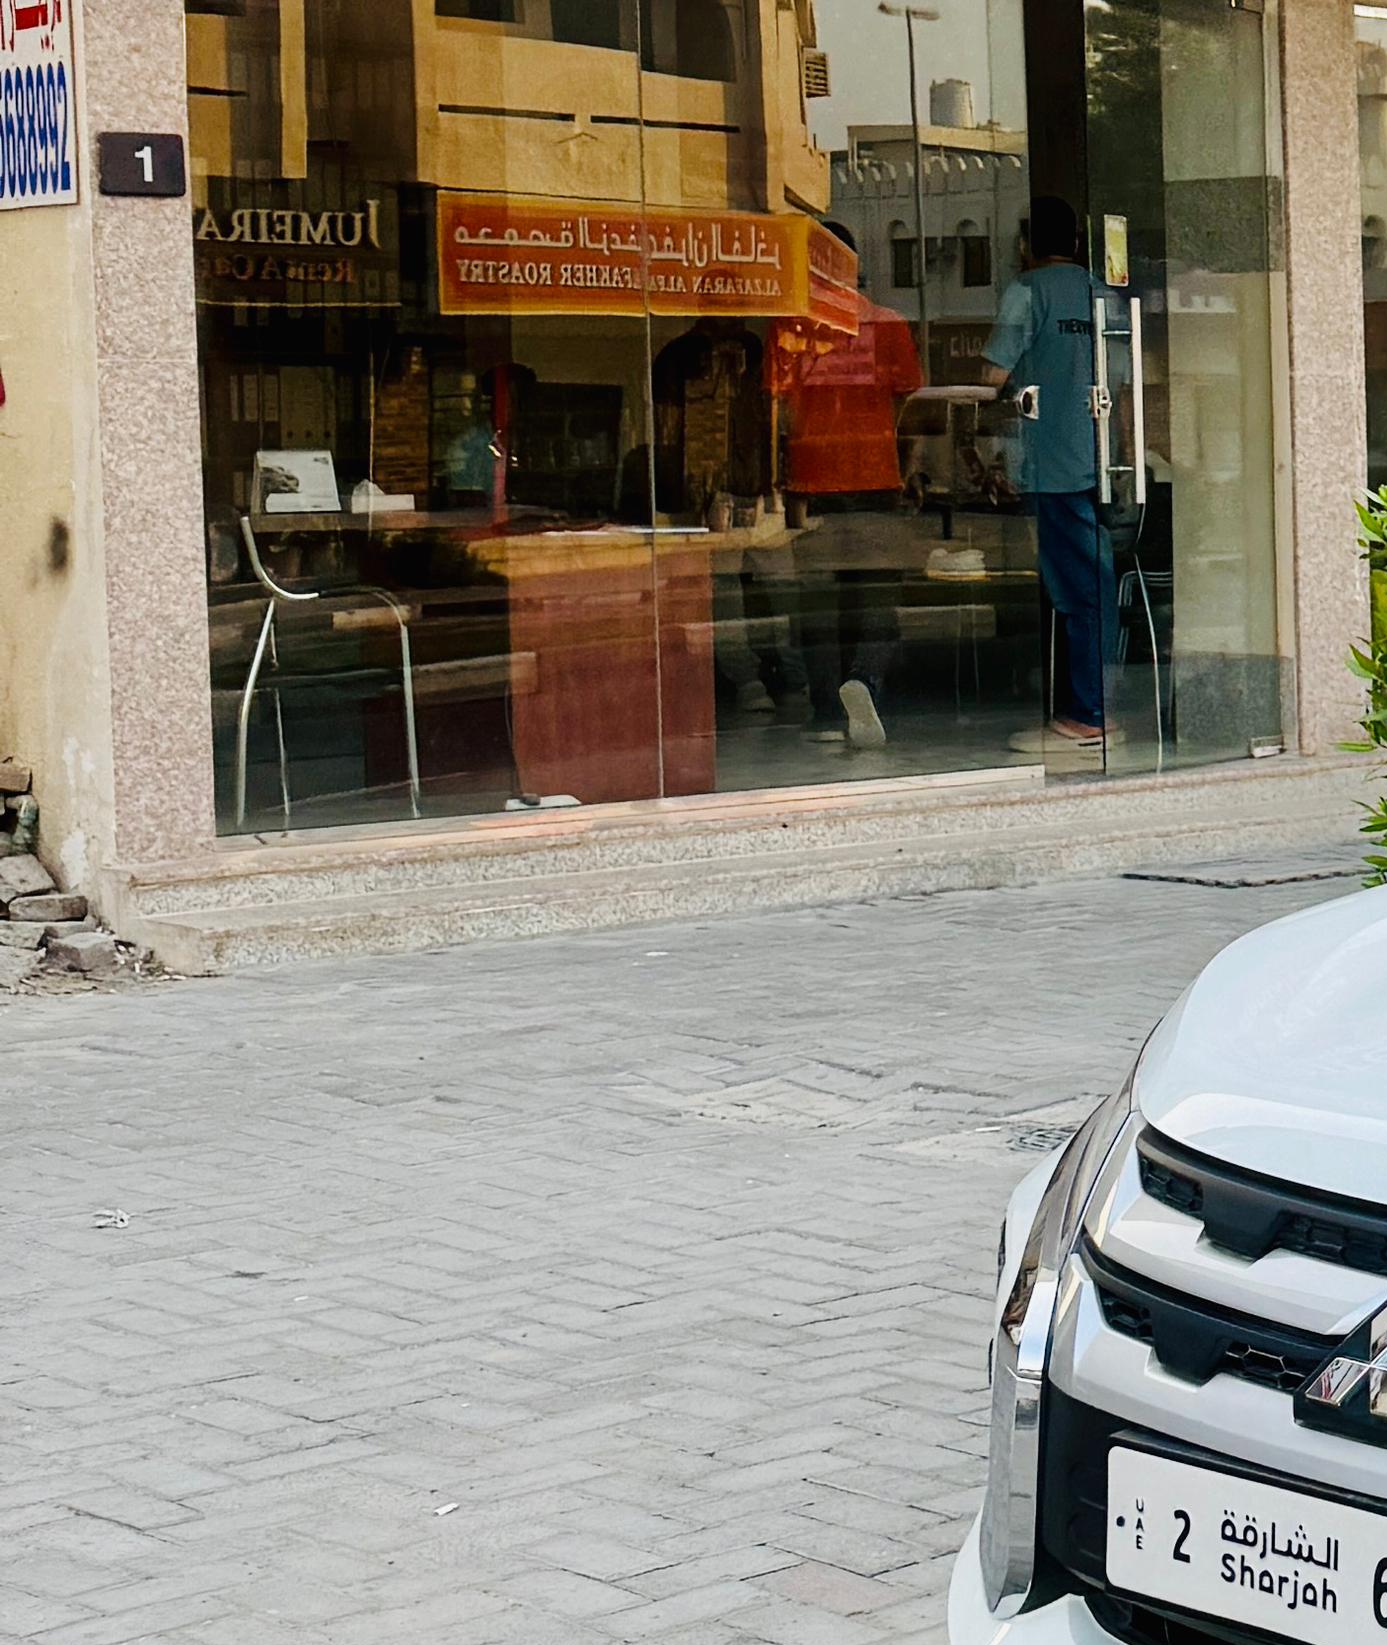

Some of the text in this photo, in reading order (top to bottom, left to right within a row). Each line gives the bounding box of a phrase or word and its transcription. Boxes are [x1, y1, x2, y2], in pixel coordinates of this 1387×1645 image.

[0, 60, 72, 199] 688992
[134, 146, 154, 182] 1
[1172, 1508, 1192, 1564] 2
[1219, 1507, 1340, 1572] الشارقة
[1219, 1551, 1339, 1614] Sharjah
